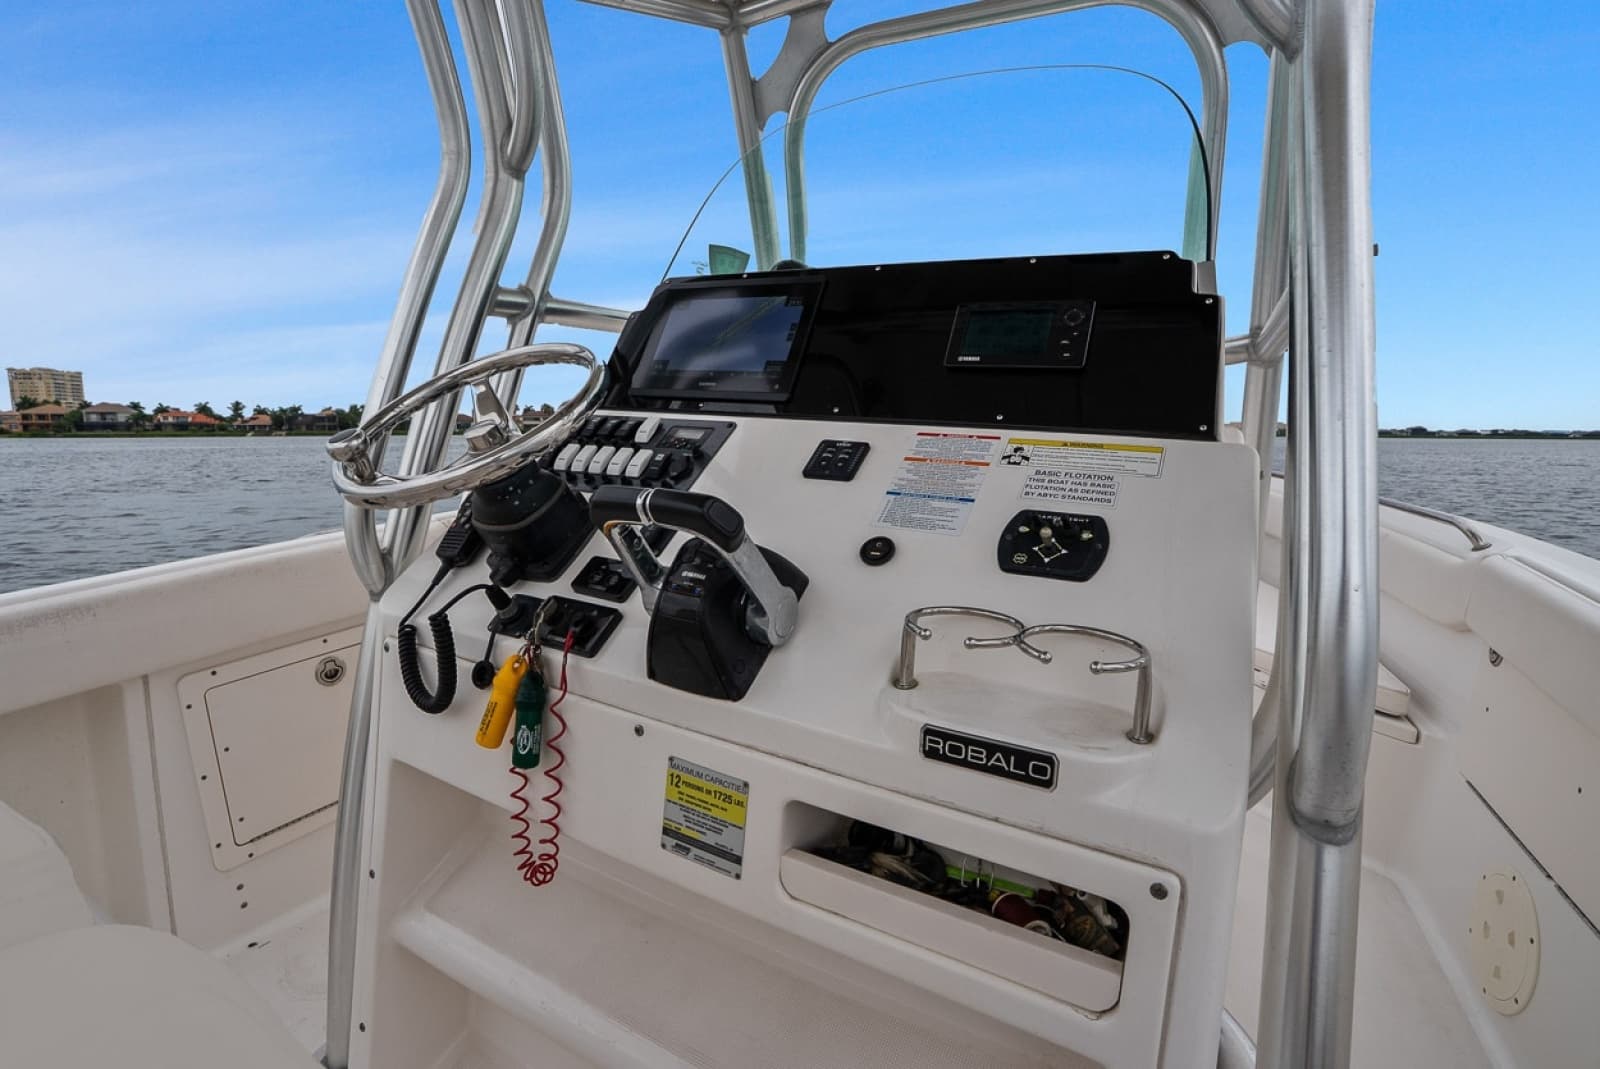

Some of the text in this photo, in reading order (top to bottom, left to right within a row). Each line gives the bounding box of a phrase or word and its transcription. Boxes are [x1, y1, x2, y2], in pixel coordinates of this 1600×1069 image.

[1035, 469, 1114, 482] BASIC FLOTATION
[1025, 484, 1067, 492] FLOTATION
[1080, 488, 1116, 496] DEFINED
[1060, 494, 1112, 504] STANDARDS
[925, 735, 1052, 781] ROBALO
[670, 759, 748, 795] MAXIMUM CAPACITIES
[670, 772, 682, 789] 12
[712, 789, 733, 805] 1725
